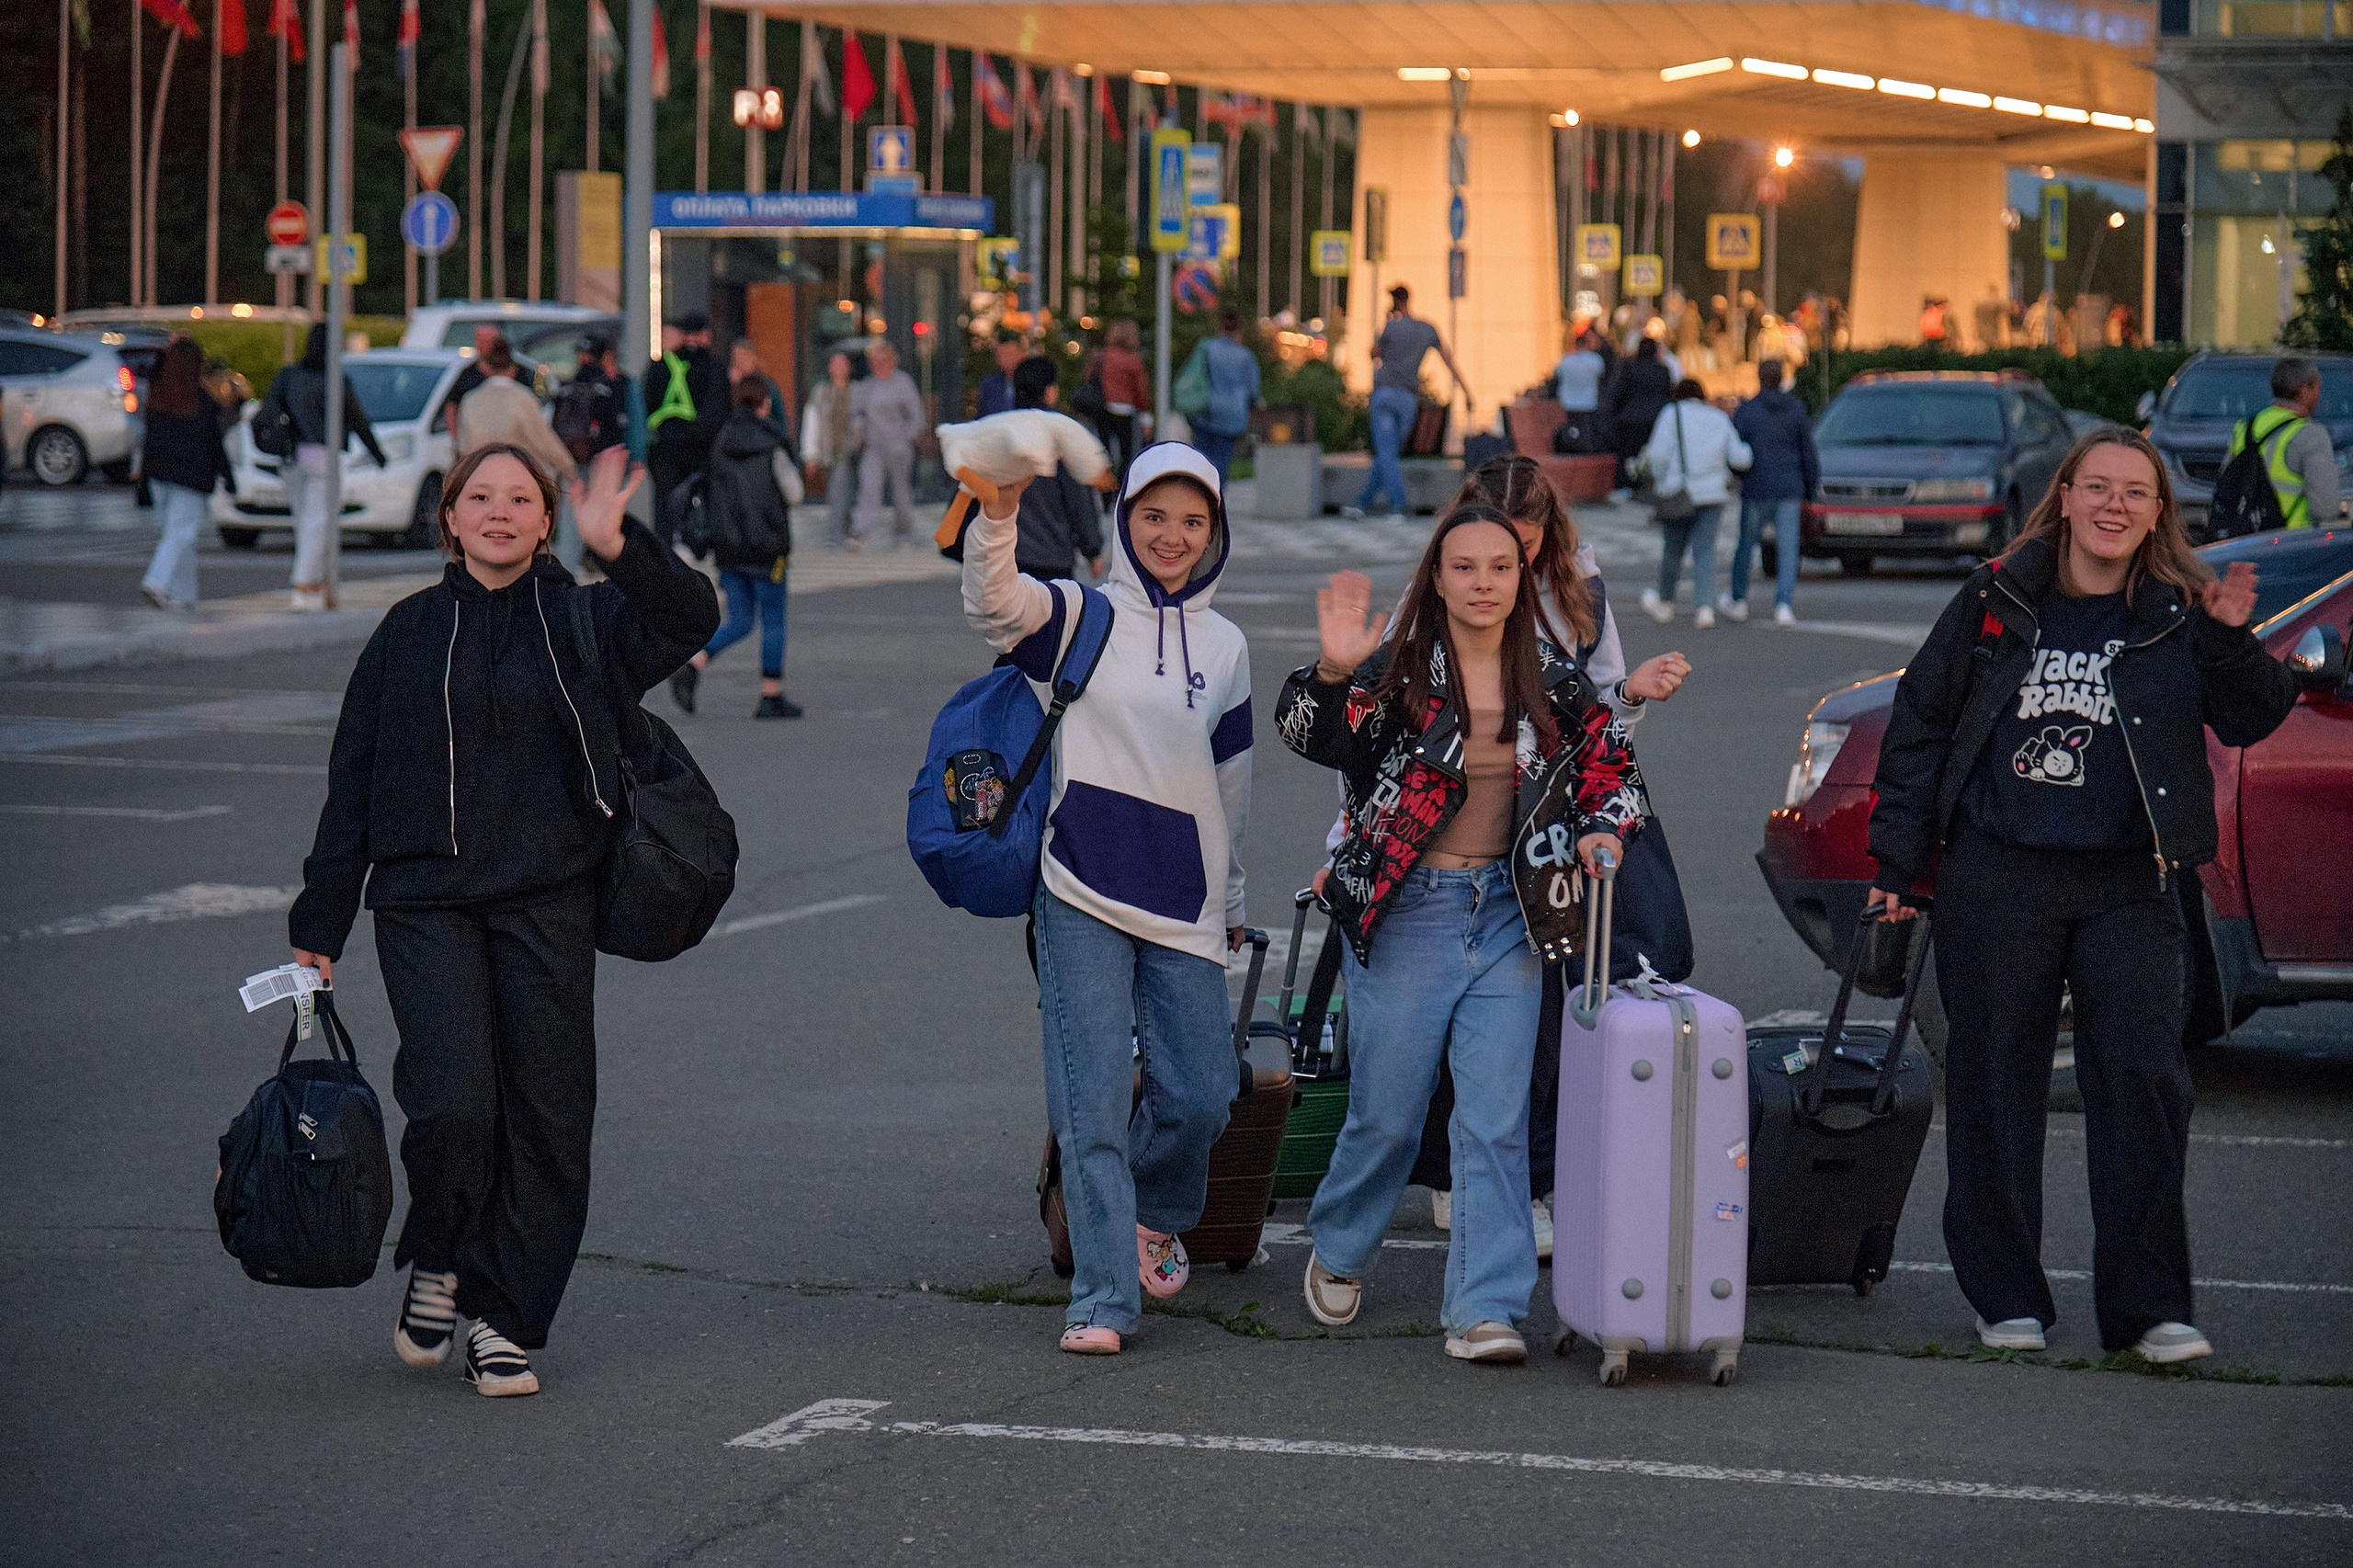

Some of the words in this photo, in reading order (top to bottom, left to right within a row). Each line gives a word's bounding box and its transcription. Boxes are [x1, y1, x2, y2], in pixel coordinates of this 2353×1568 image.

[2017, 682, 2115, 725] Rabbit
[1526, 824, 1575, 869] CR
[300, 993, 311, 1031] NSFER
